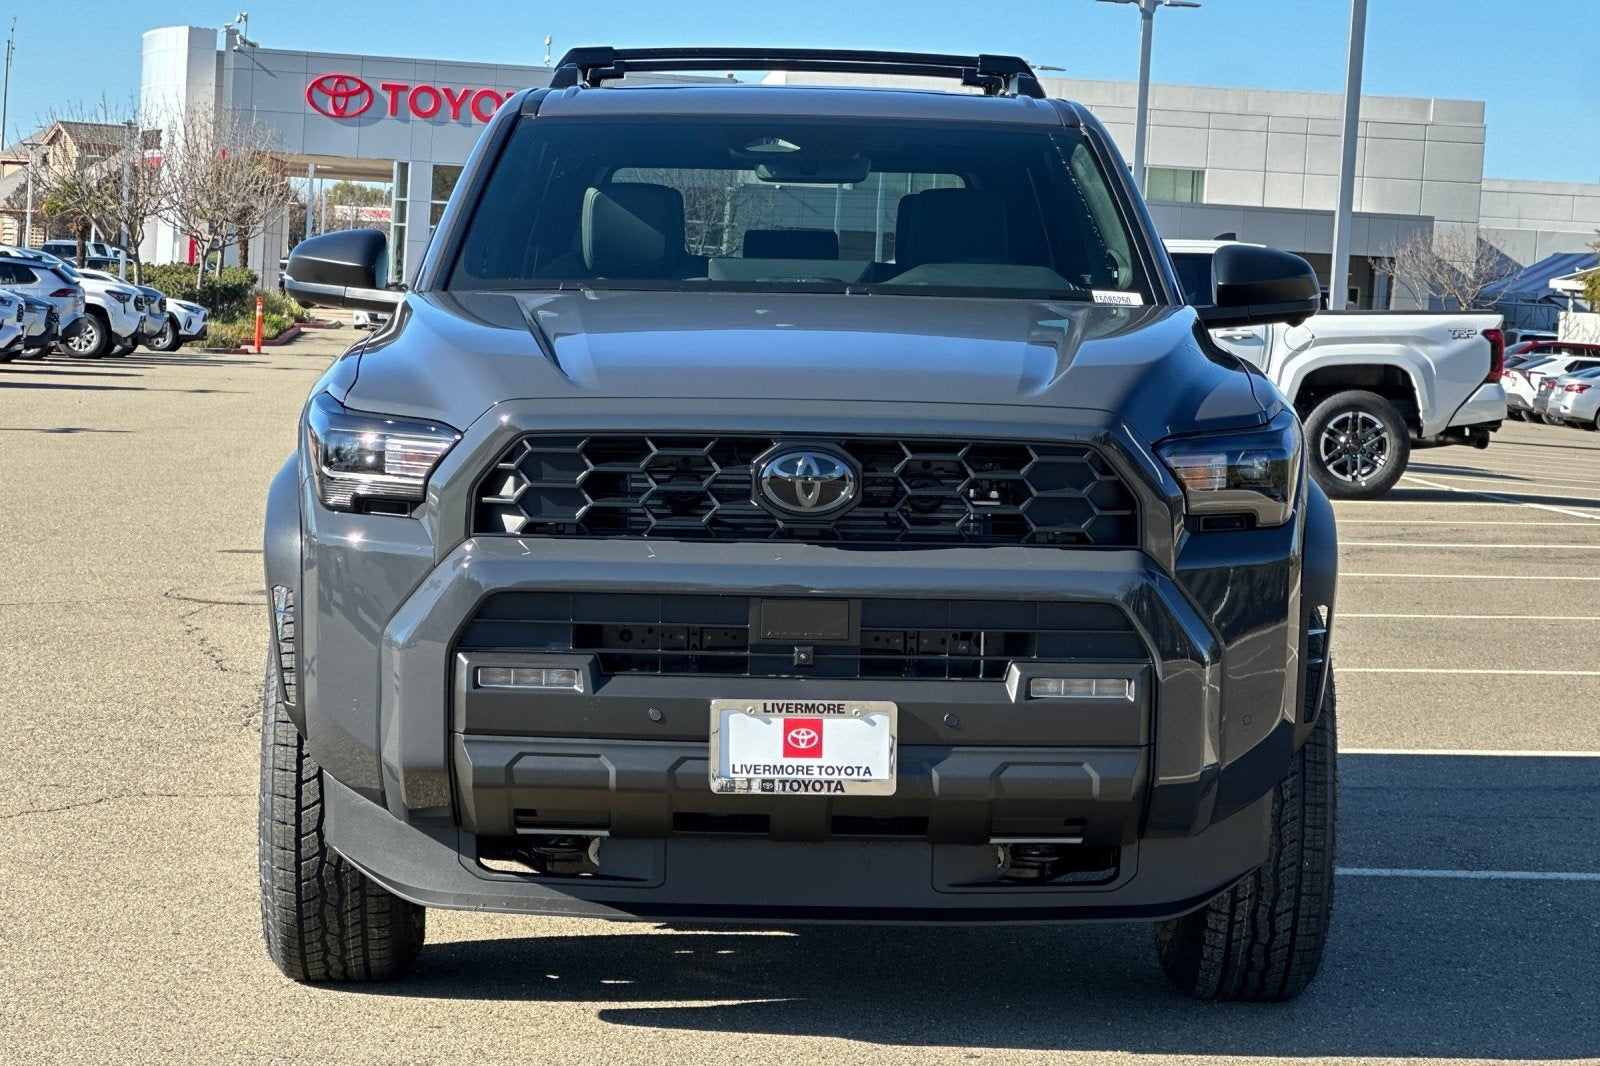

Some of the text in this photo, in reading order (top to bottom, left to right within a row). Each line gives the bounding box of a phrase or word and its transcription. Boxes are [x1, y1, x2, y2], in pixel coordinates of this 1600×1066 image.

[381, 83, 516, 123] TOYO
[763, 702, 846, 714] LIVERMORE
[731, 764, 872, 777] LIVERMORE TOYOTA
[780, 780, 845, 793] TOYOTA
